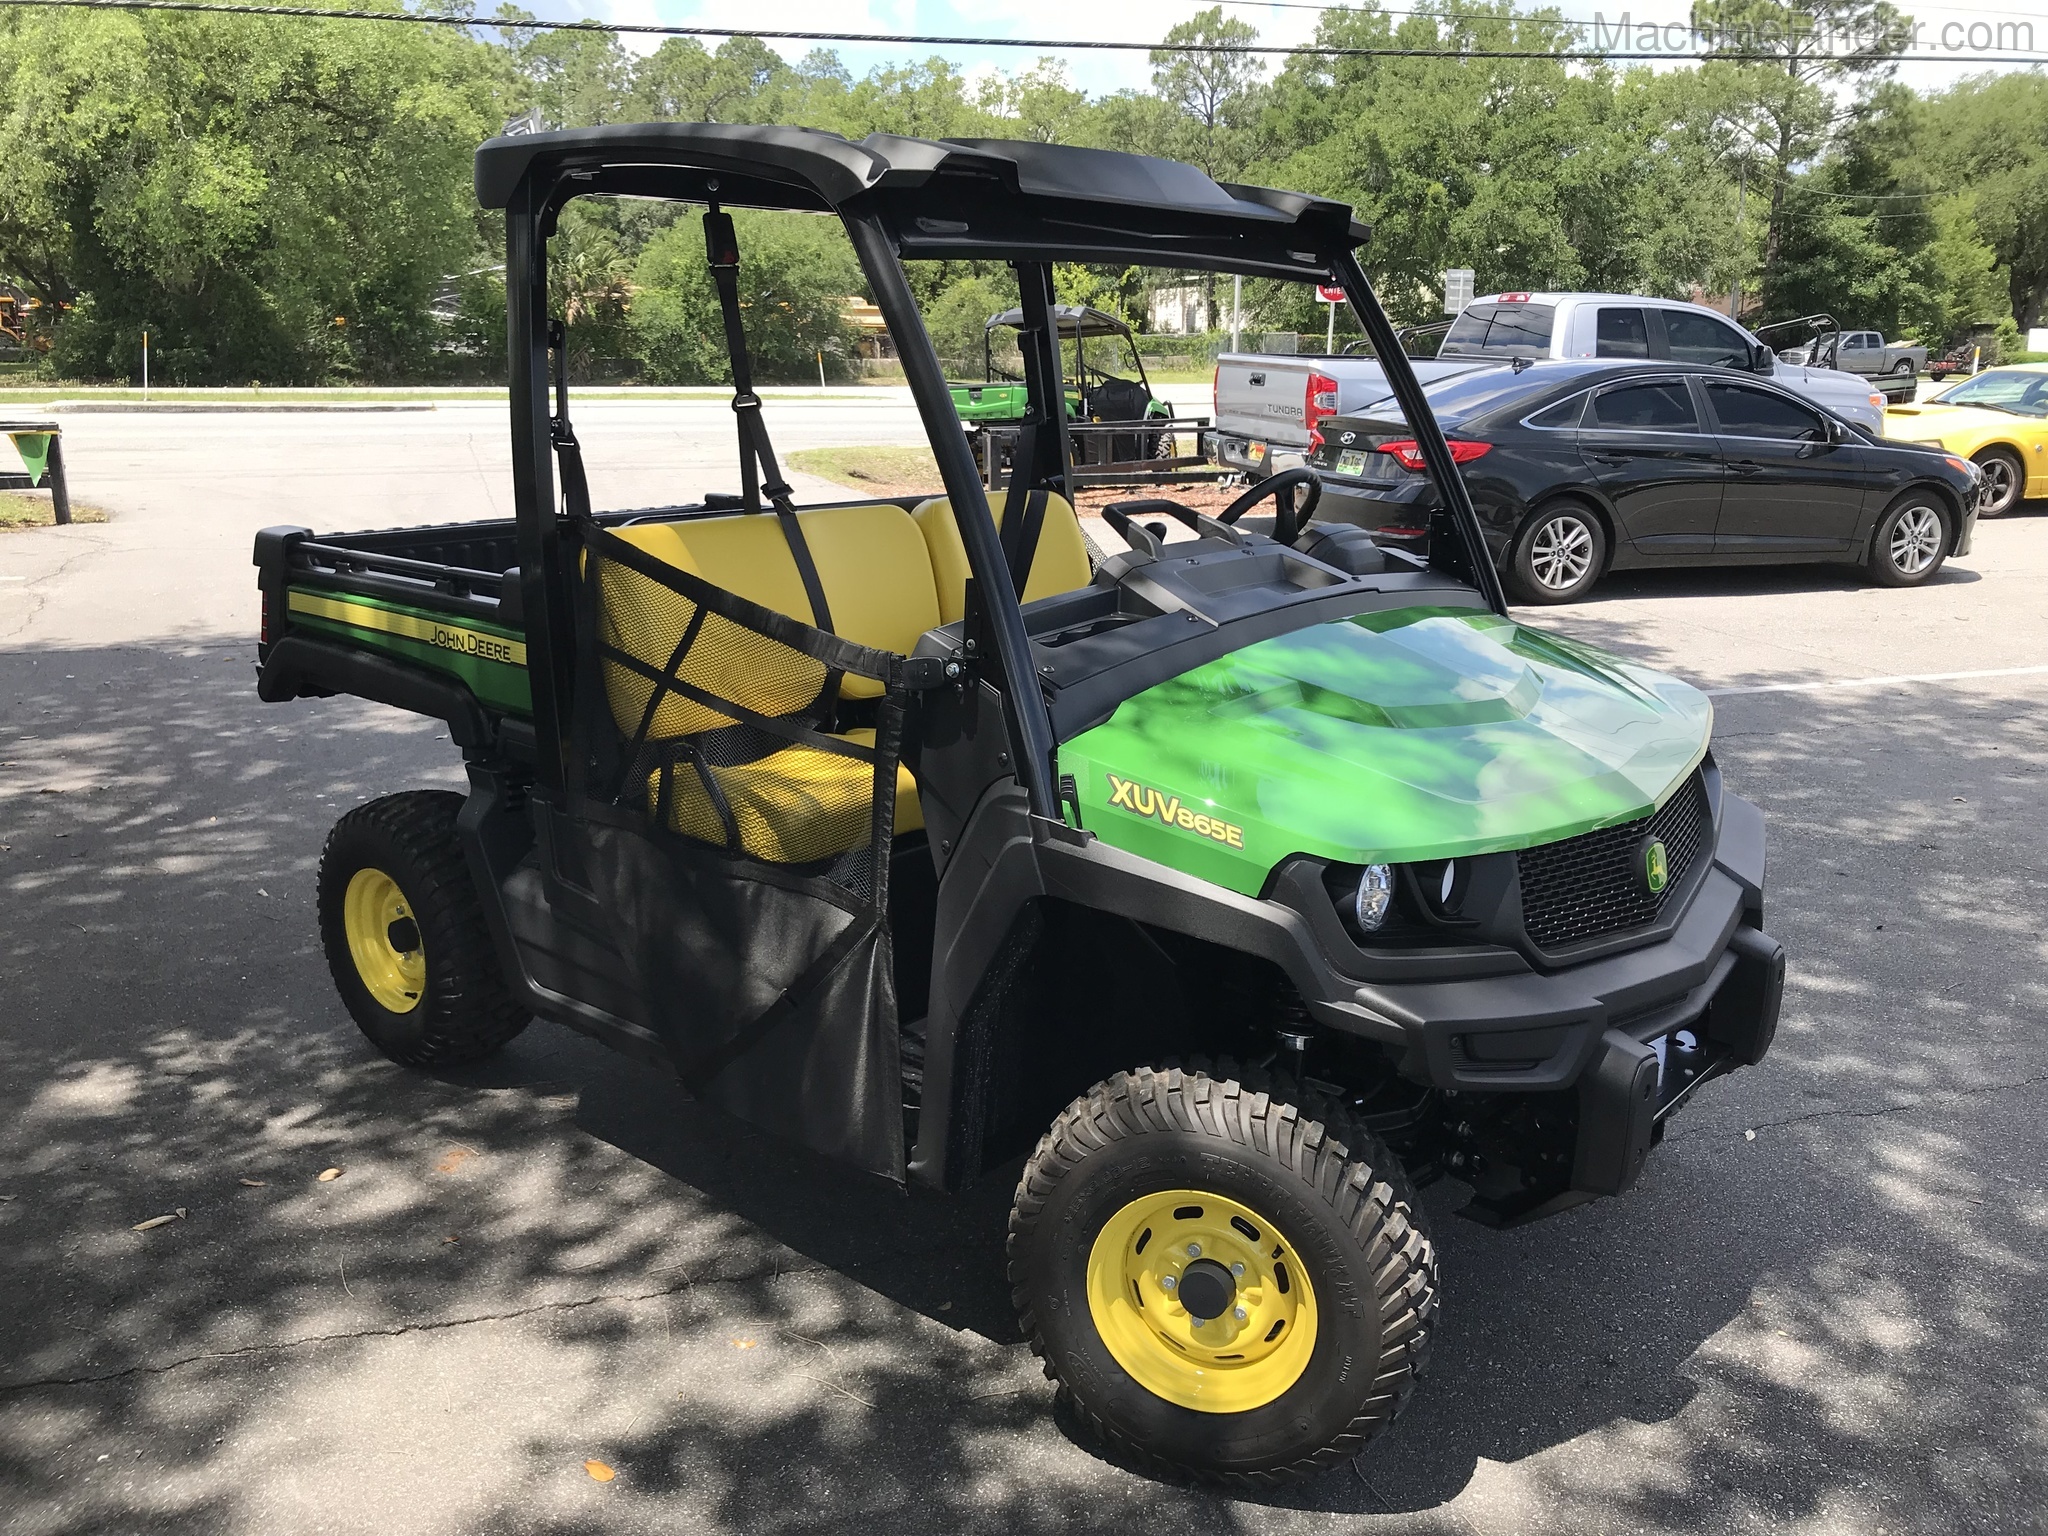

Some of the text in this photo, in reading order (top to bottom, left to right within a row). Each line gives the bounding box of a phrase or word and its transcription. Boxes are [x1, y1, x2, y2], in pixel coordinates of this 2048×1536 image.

[1267, 403, 1303, 416] TUNDRA
[430, 625, 512, 661] JOHN DEERE
[1106, 773, 1244, 850] XUV865E
